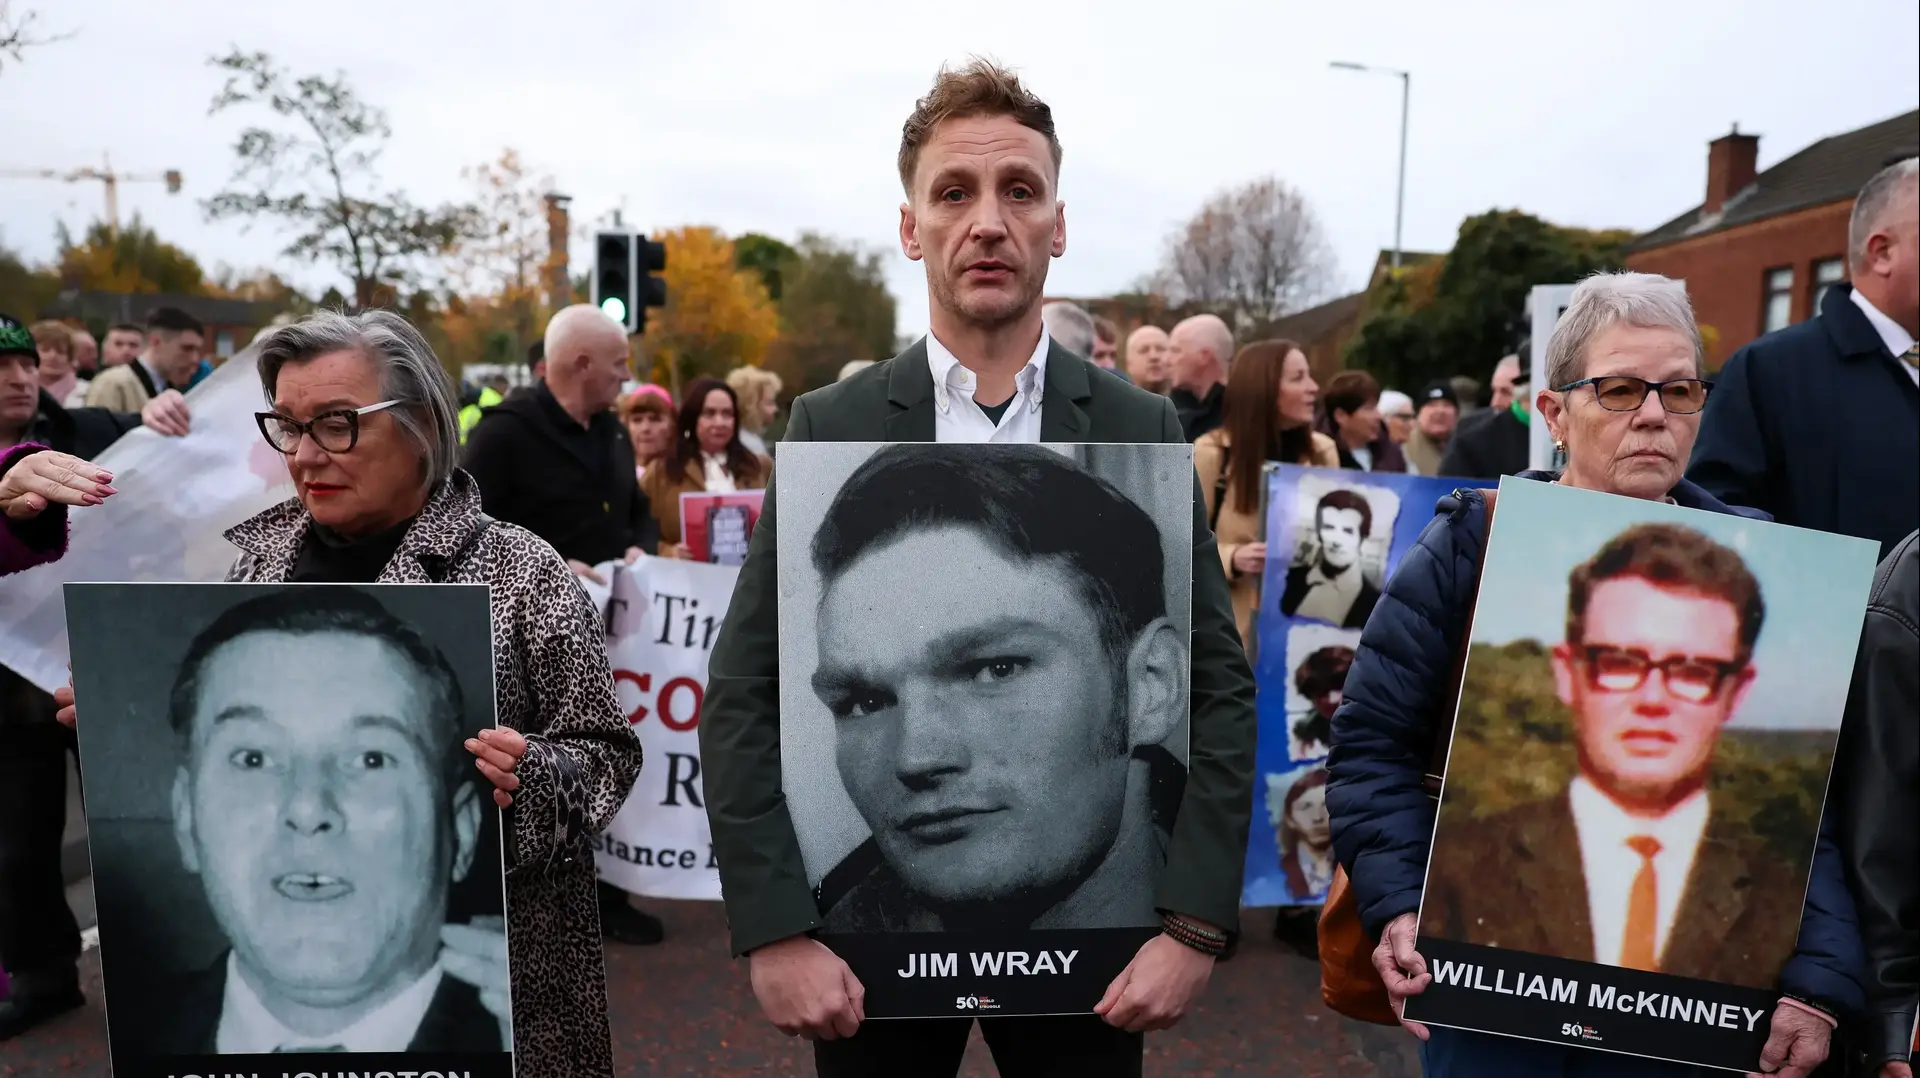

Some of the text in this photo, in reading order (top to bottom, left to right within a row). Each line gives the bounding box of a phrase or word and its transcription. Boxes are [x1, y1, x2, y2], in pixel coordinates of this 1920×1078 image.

[897, 949, 1079, 978] JIM WRAY
[1431, 958, 1579, 1004] WILLIAM
[1587, 983, 1765, 1032] McKINNEY
